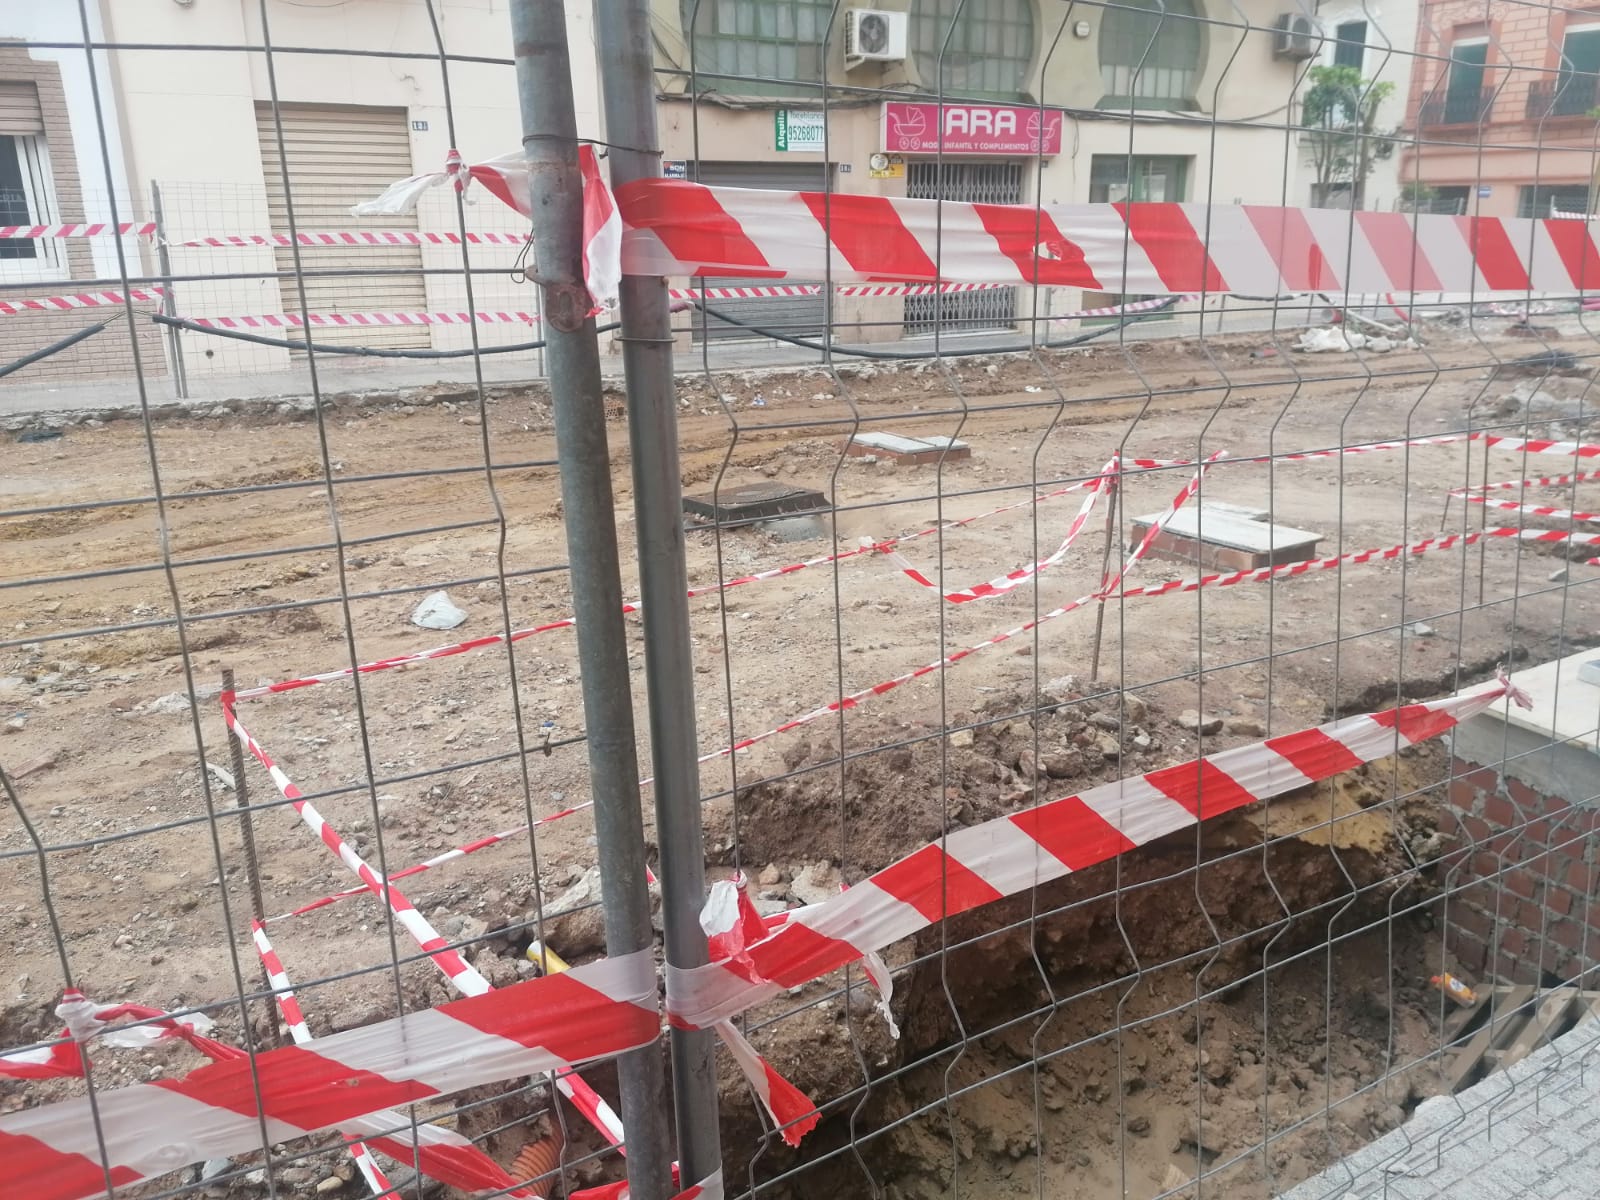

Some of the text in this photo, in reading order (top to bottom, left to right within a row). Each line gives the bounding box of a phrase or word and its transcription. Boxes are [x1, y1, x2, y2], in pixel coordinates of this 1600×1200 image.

[777, 109, 786, 148] Alquila
[788, 125, 825, 141] 95268077
[922, 141, 942, 149] MOD
[944, 142, 972, 150] INFANTIL
[980, 142, 1029, 151] COMPLEMENTOS
